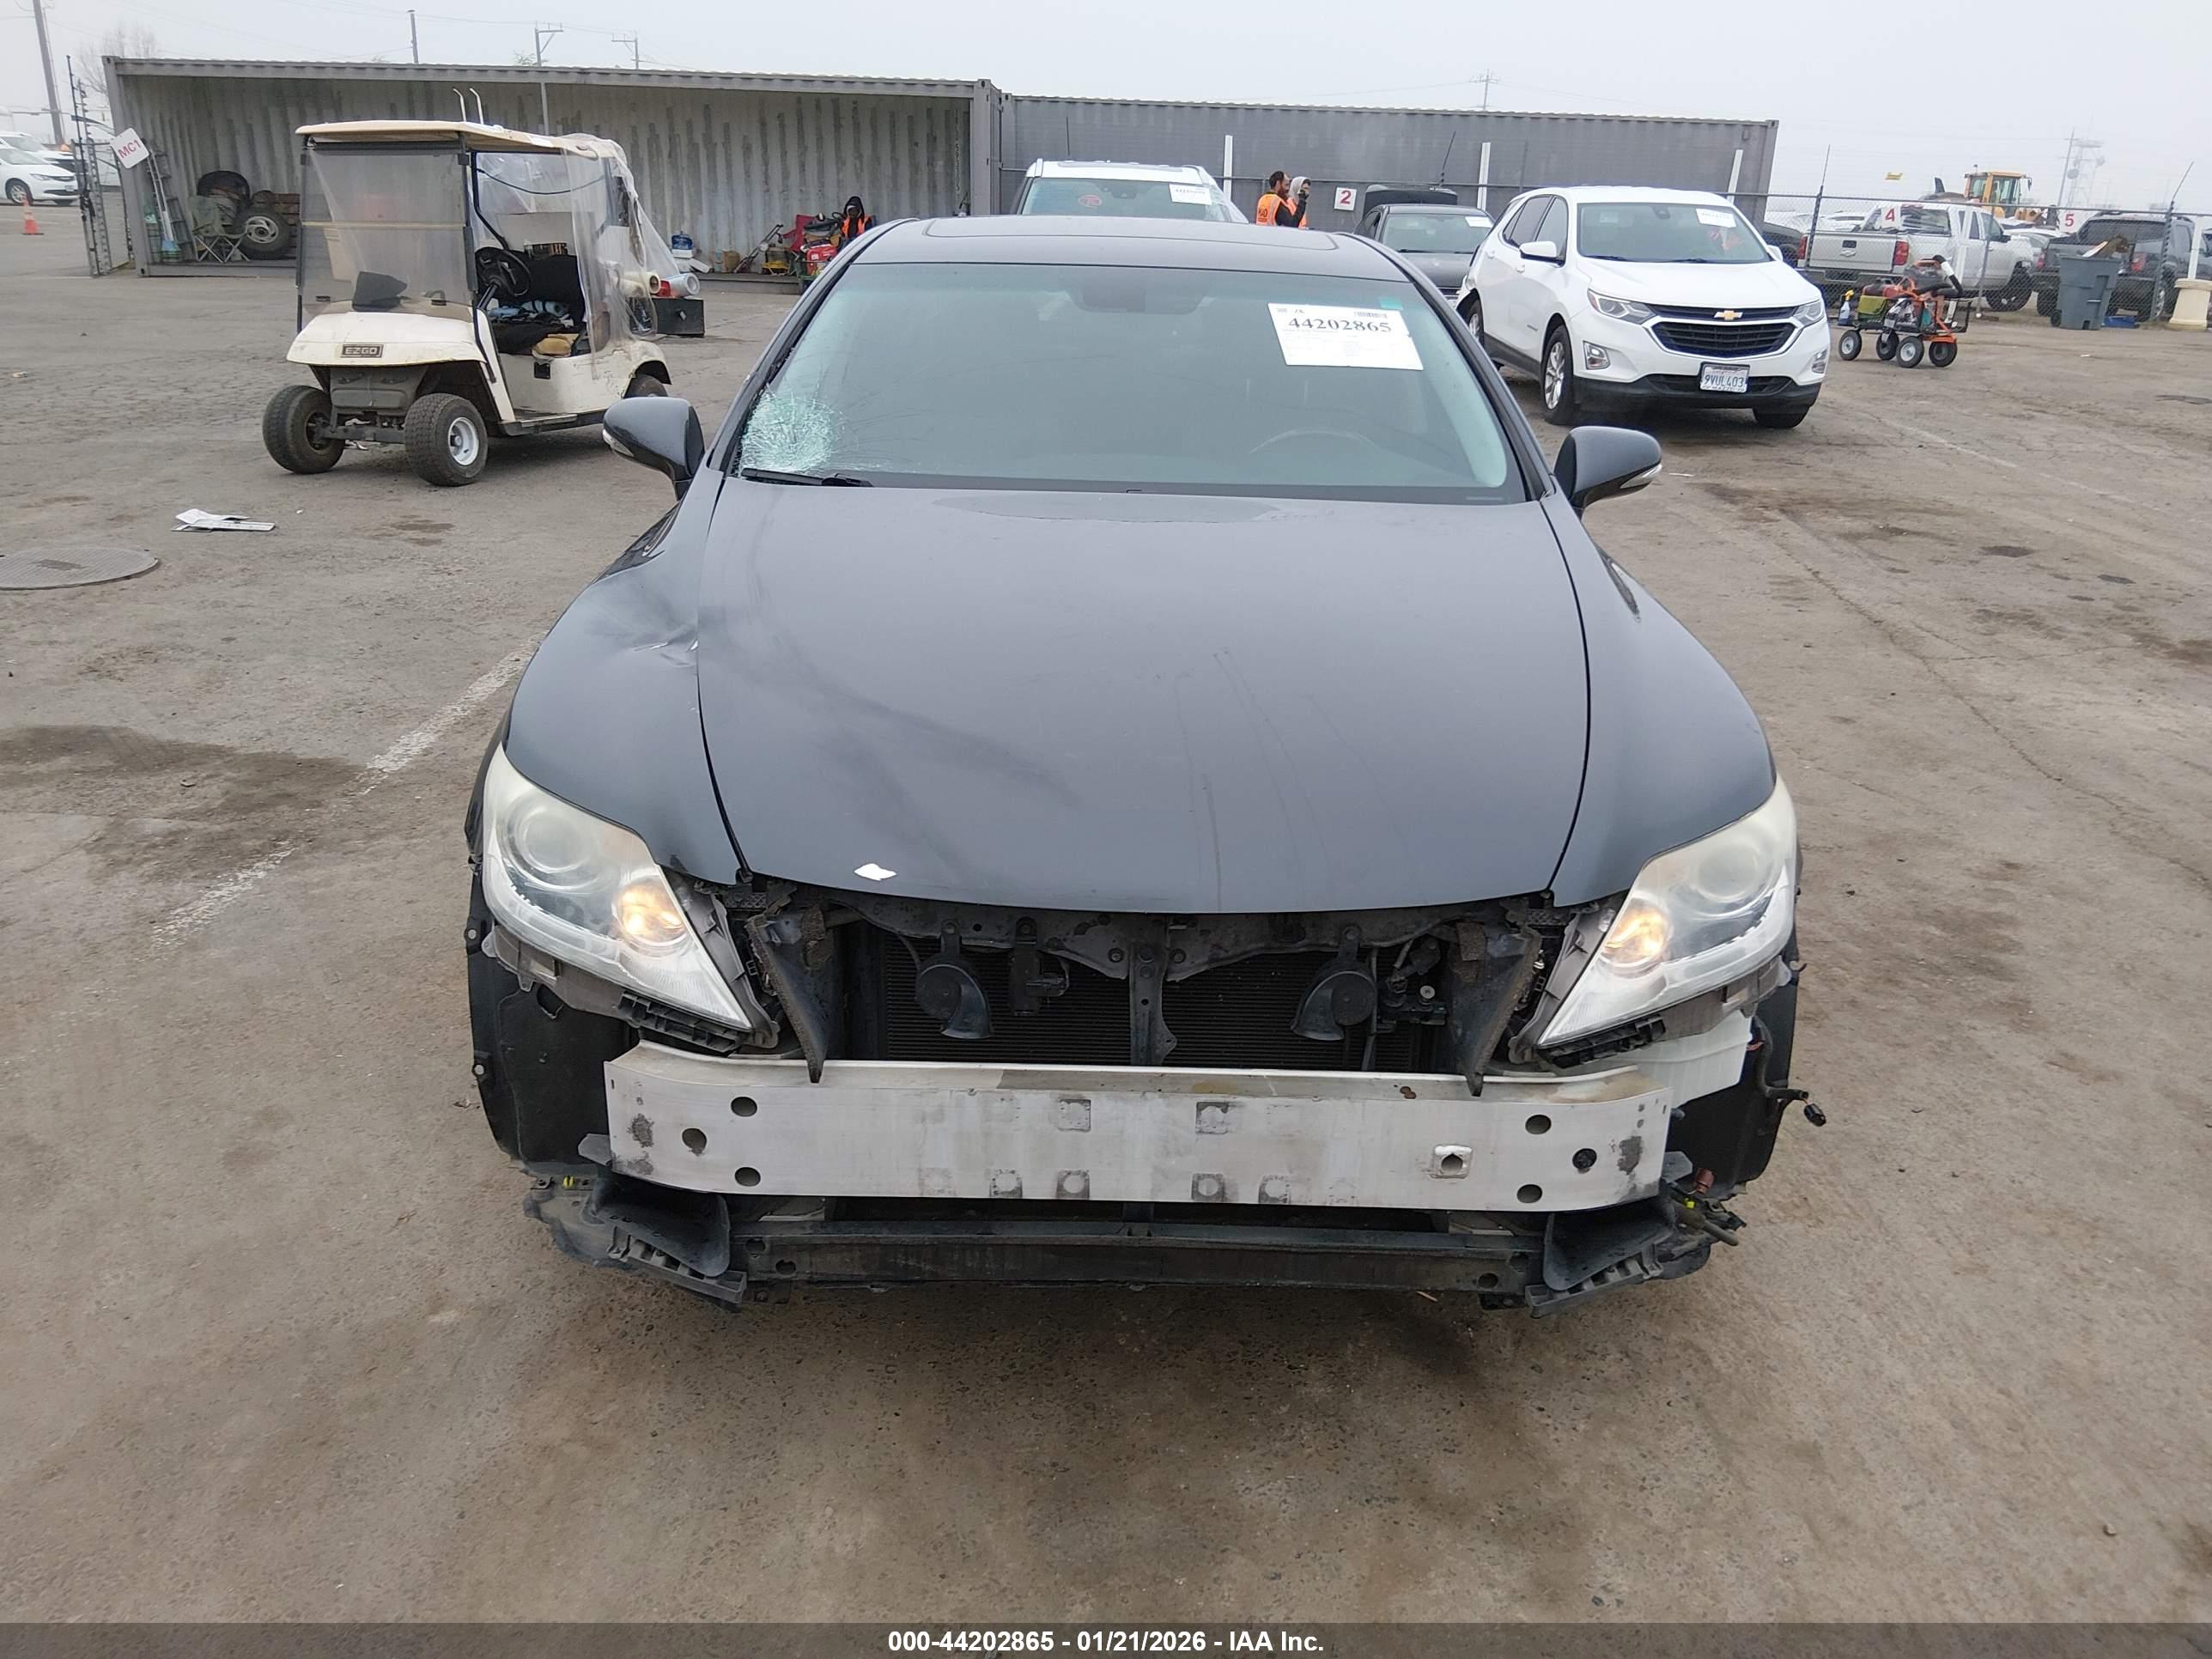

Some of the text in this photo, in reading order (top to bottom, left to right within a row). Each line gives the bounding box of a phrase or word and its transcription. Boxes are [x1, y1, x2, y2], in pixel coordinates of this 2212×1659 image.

[118, 140, 141, 159] MC1
[1340, 190, 1352, 204] 2
[1885, 208, 1895, 222] 4
[2064, 213, 2075, 227] 5
[1288, 318, 1392, 333] 44202865
[1704, 374, 1744, 388] 9VUL403
